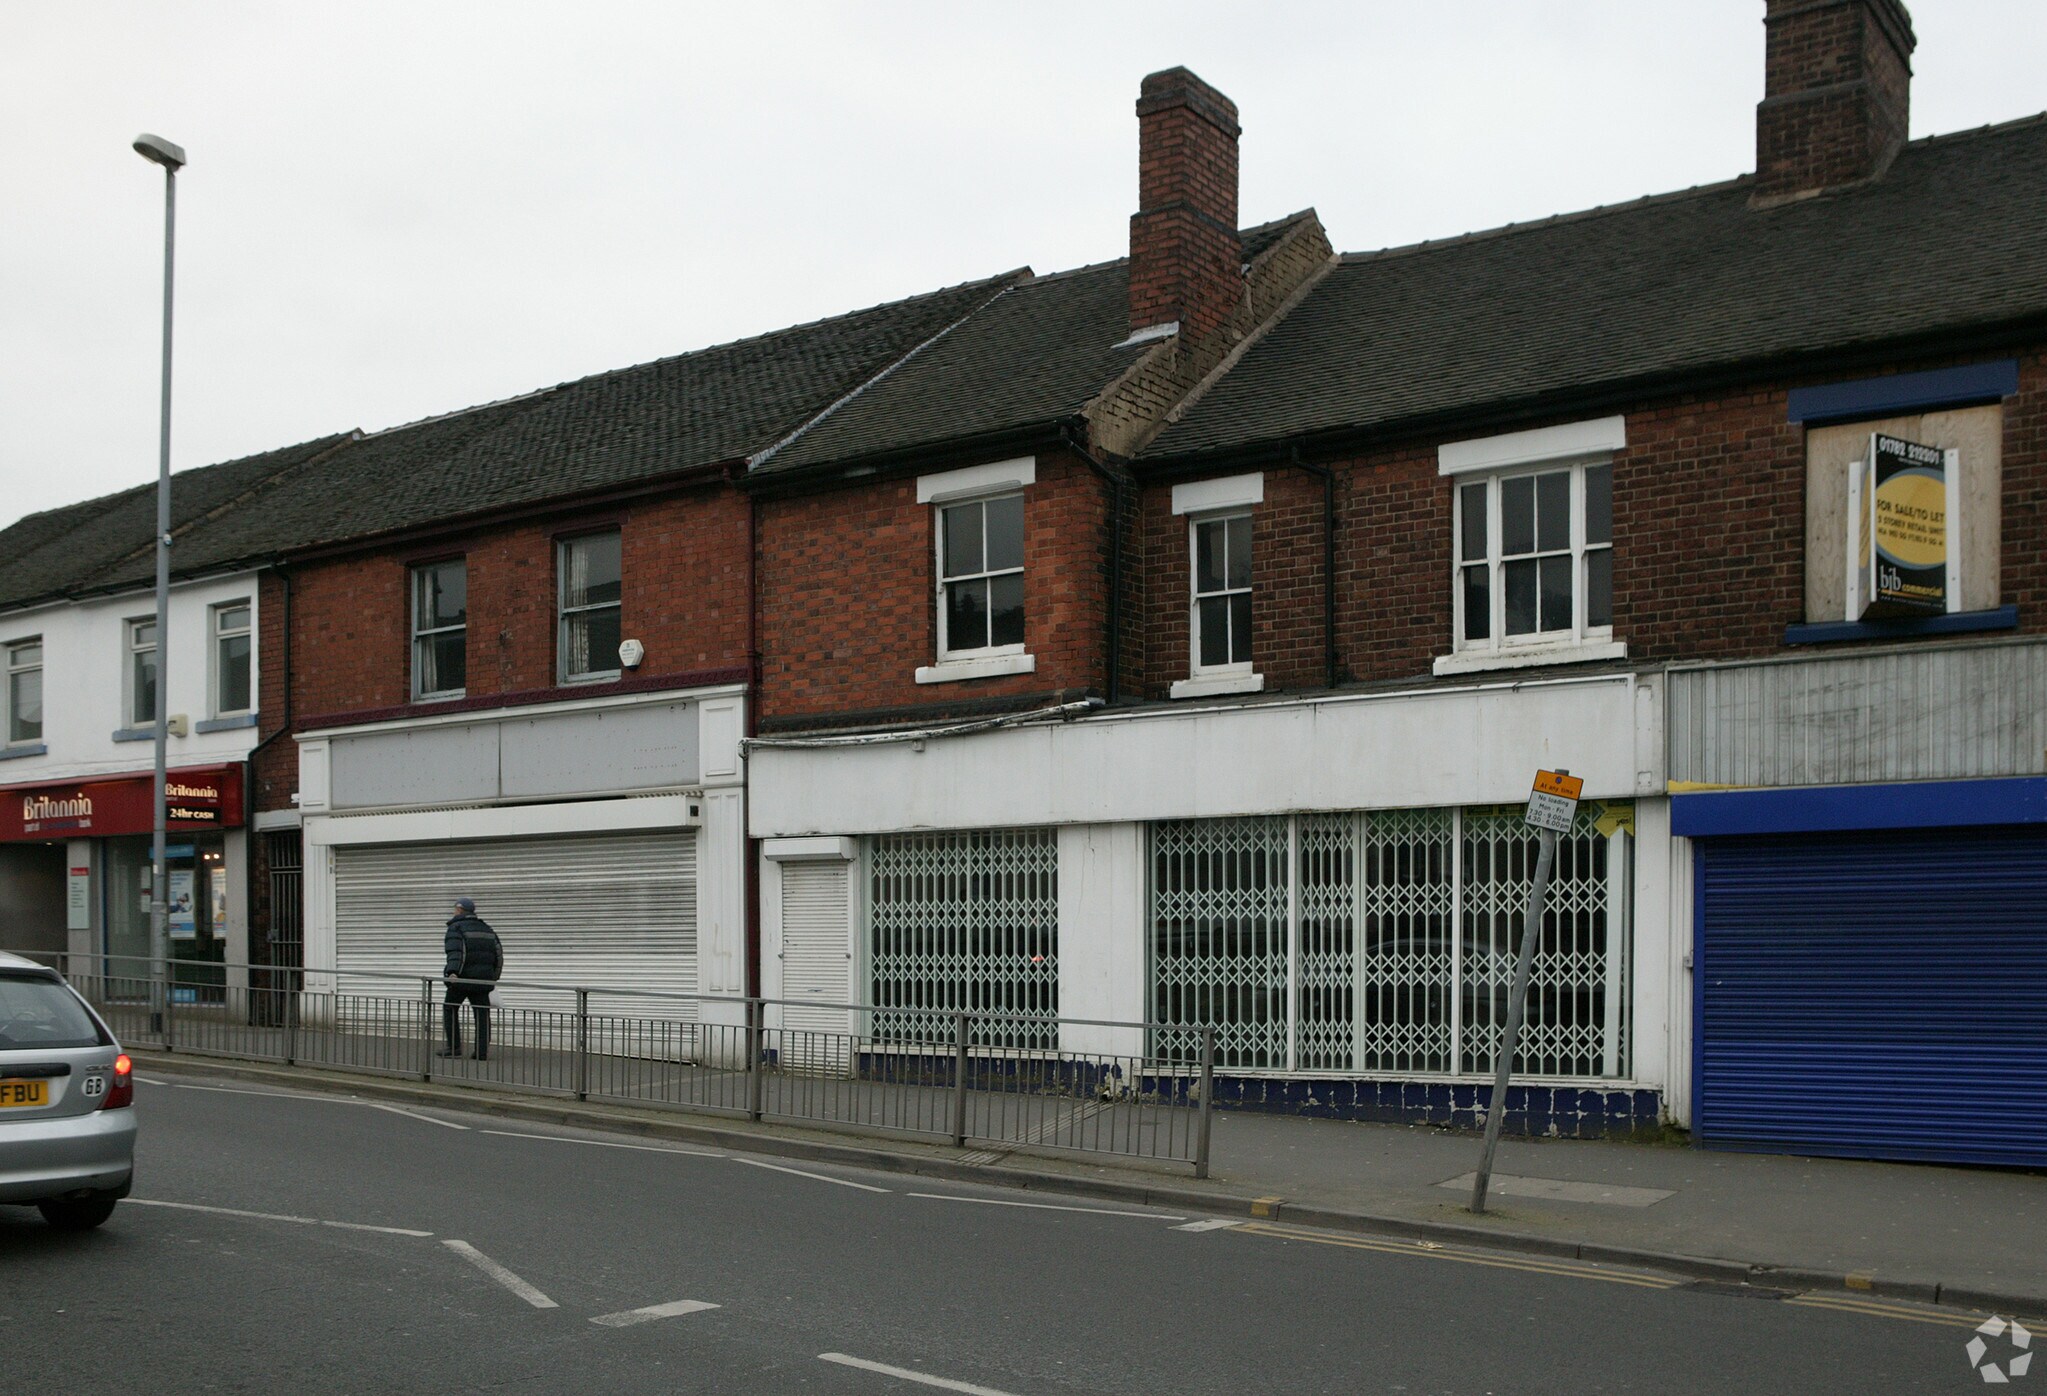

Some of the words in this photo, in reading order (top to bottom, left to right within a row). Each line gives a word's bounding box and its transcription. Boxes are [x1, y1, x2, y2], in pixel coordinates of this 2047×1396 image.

[1877, 499, 1891, 512] FOR
[1930, 511, 1944, 523] LET
[1880, 565, 1901, 595] bjb
[1901, 583, 1943, 597] commercial
[165, 783, 218, 798] Britannia
[1561, 787, 1573, 795] time
[23, 792, 92, 820] Britannia
[1538, 803, 1551, 811] Mon
[1548, 797, 1569, 807] loading
[170, 808, 193, 818] 24hr
[193, 811, 214, 819] CASH
[1527, 815, 1541, 823] 4.30
[1529, 808, 1543, 817] 7.30
[1, 1083, 40, 1103] FBU
[86, 1078, 102, 1095] GB
